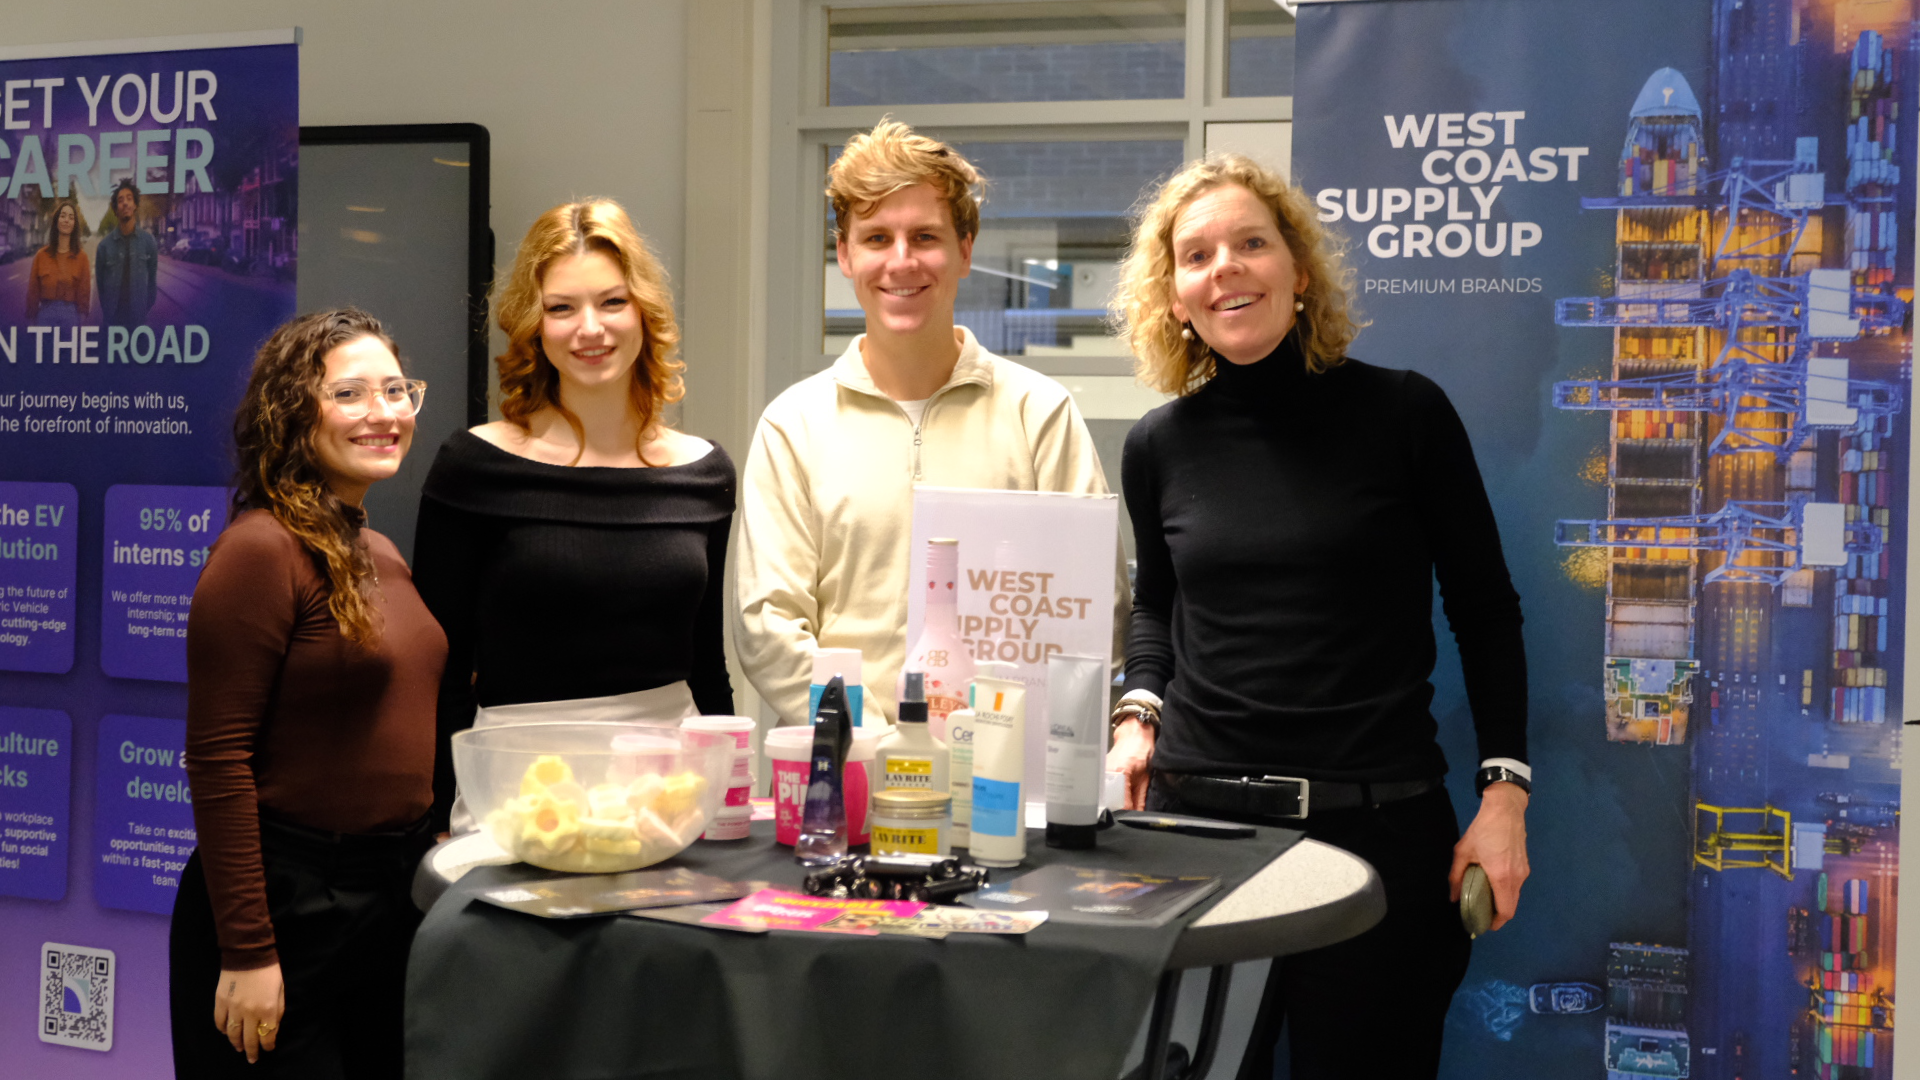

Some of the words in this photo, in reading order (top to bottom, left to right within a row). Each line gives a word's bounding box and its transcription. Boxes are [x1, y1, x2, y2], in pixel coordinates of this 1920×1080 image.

[0, 78, 65, 130] ET
[76, 70, 218, 127] YOUR
[1384, 110, 1526, 148] WEST
[1421, 147, 1589, 184] COAST
[1316, 185, 1503, 222] SUPPLY
[1367, 222, 1543, 258] GROUP
[1365, 278, 1455, 294] PREMIUM
[1462, 278, 1542, 294] BRANDS
[0, 326, 17, 364] N
[27, 326, 100, 364] THE
[107, 325, 210, 364] ROAD
[0, 394, 16, 408] ur
[19, 391, 77, 412] journey
[82, 392, 130, 412] begins
[134, 392, 163, 408] with
[167, 395, 189, 412] us,
[0, 416, 19, 432] he
[25, 415, 91, 433] forefront
[95, 416, 110, 433] of
[114, 417, 192, 434] innovation.
[35, 504, 65, 527] EV
[139, 508, 183, 532] 95%
[188, 509, 211, 532] of
[113, 540, 184, 565] interns
[189, 546, 210, 567] st
[967, 569, 1054, 594] WEST
[7, 586, 24, 599] the
[26, 586, 56, 599] future
[57, 587, 68, 599] of
[111, 591, 127, 602] We
[129, 592, 152, 604] offer
[154, 595, 177, 605] more
[179, 594, 193, 605] tha
[12, 601, 49, 614] Vehicle
[127, 607, 175, 622] internship;
[990, 594, 1092, 620] COAST
[1, 617, 67, 632] cutting-edge
[128, 623, 175, 638] long-term
[957, 615, 1039, 641] PPLY
[0, 632, 31, 647] ology.
[952, 726, 974, 741] Cer
[0, 732, 59, 756] ulture
[120, 740, 174, 767] Grow
[778, 770, 801, 783] THE
[886, 773, 931, 783] LAYRITE
[127, 776, 192, 804] develo
[5, 812, 54, 826] workplace
[5, 828, 57, 842] supportive
[128, 822, 151, 836] Take
[153, 827, 166, 837] on
[1, 841, 18, 852] fun
[20, 844, 49, 857] social
[110, 839, 175, 855] opportunities
[102, 852, 131, 865] within
[133, 857, 139, 866] a
[153, 874, 179, 887] team.
